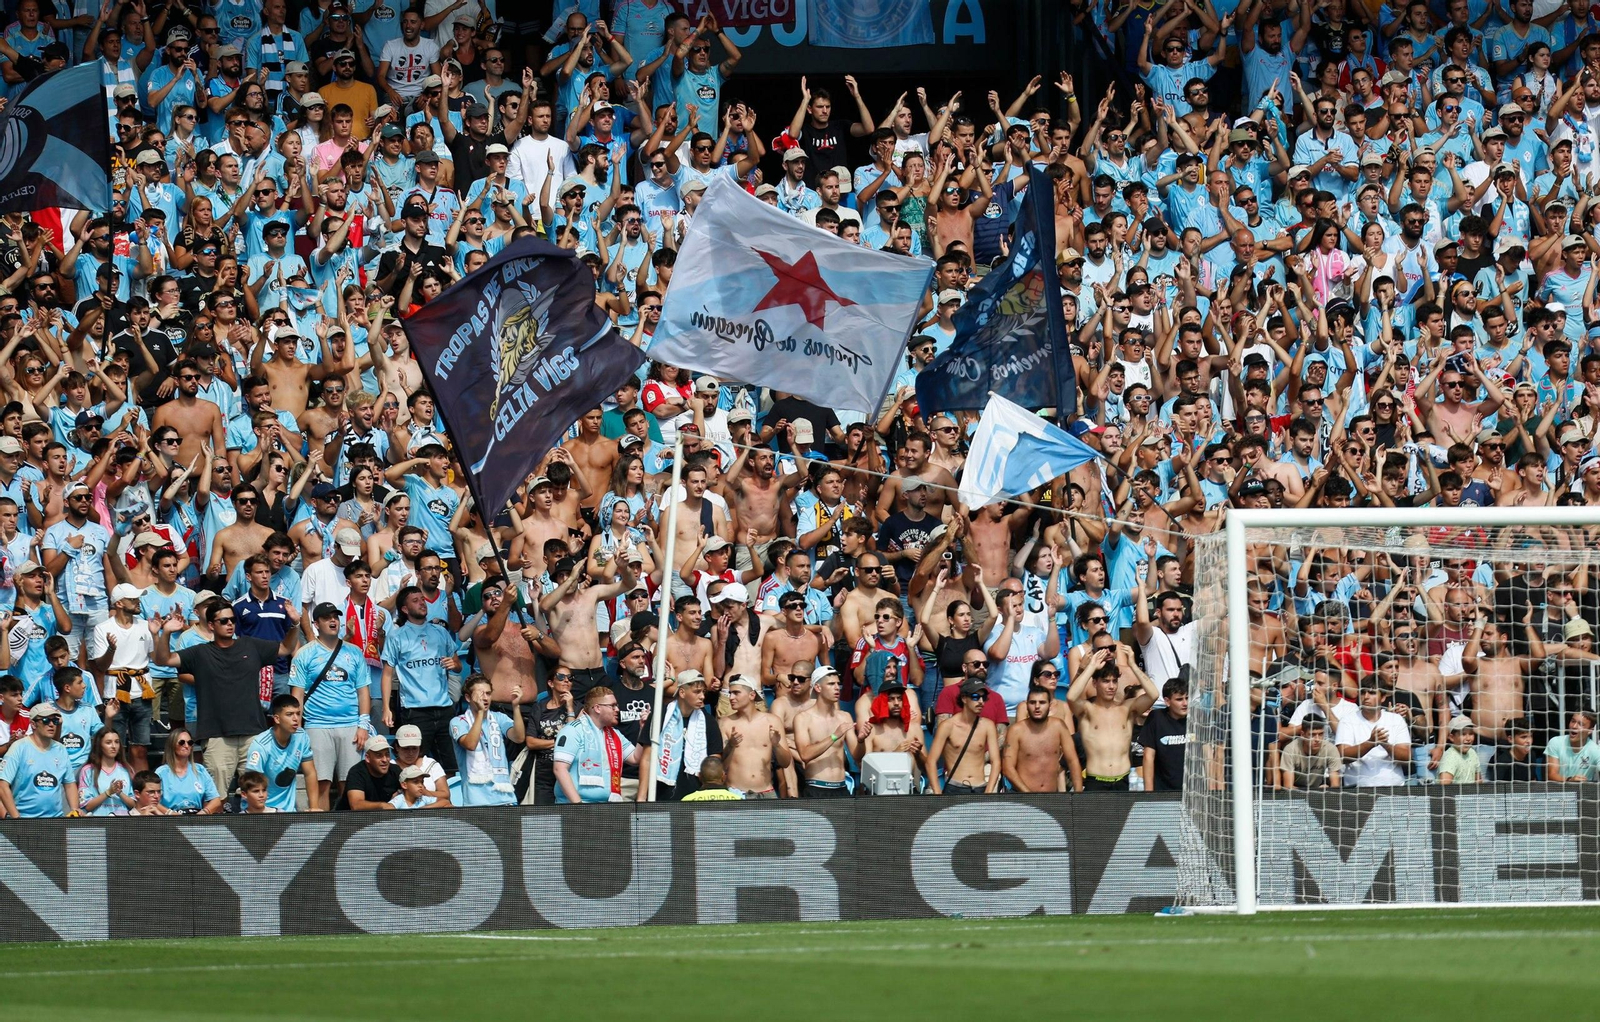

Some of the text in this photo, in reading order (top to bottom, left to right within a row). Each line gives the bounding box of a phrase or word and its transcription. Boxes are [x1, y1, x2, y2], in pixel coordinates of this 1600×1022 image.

[722, 0, 790, 20] VIGO
[435, 300, 490, 380] TROPAS
[482, 271, 501, 309] DE
[495, 346, 580, 441] CELTA VIGO
[898, 528, 920, 542] MUSTANG
[177, 809, 840, 936] YOUR
[910, 792, 1583, 917] GAME
